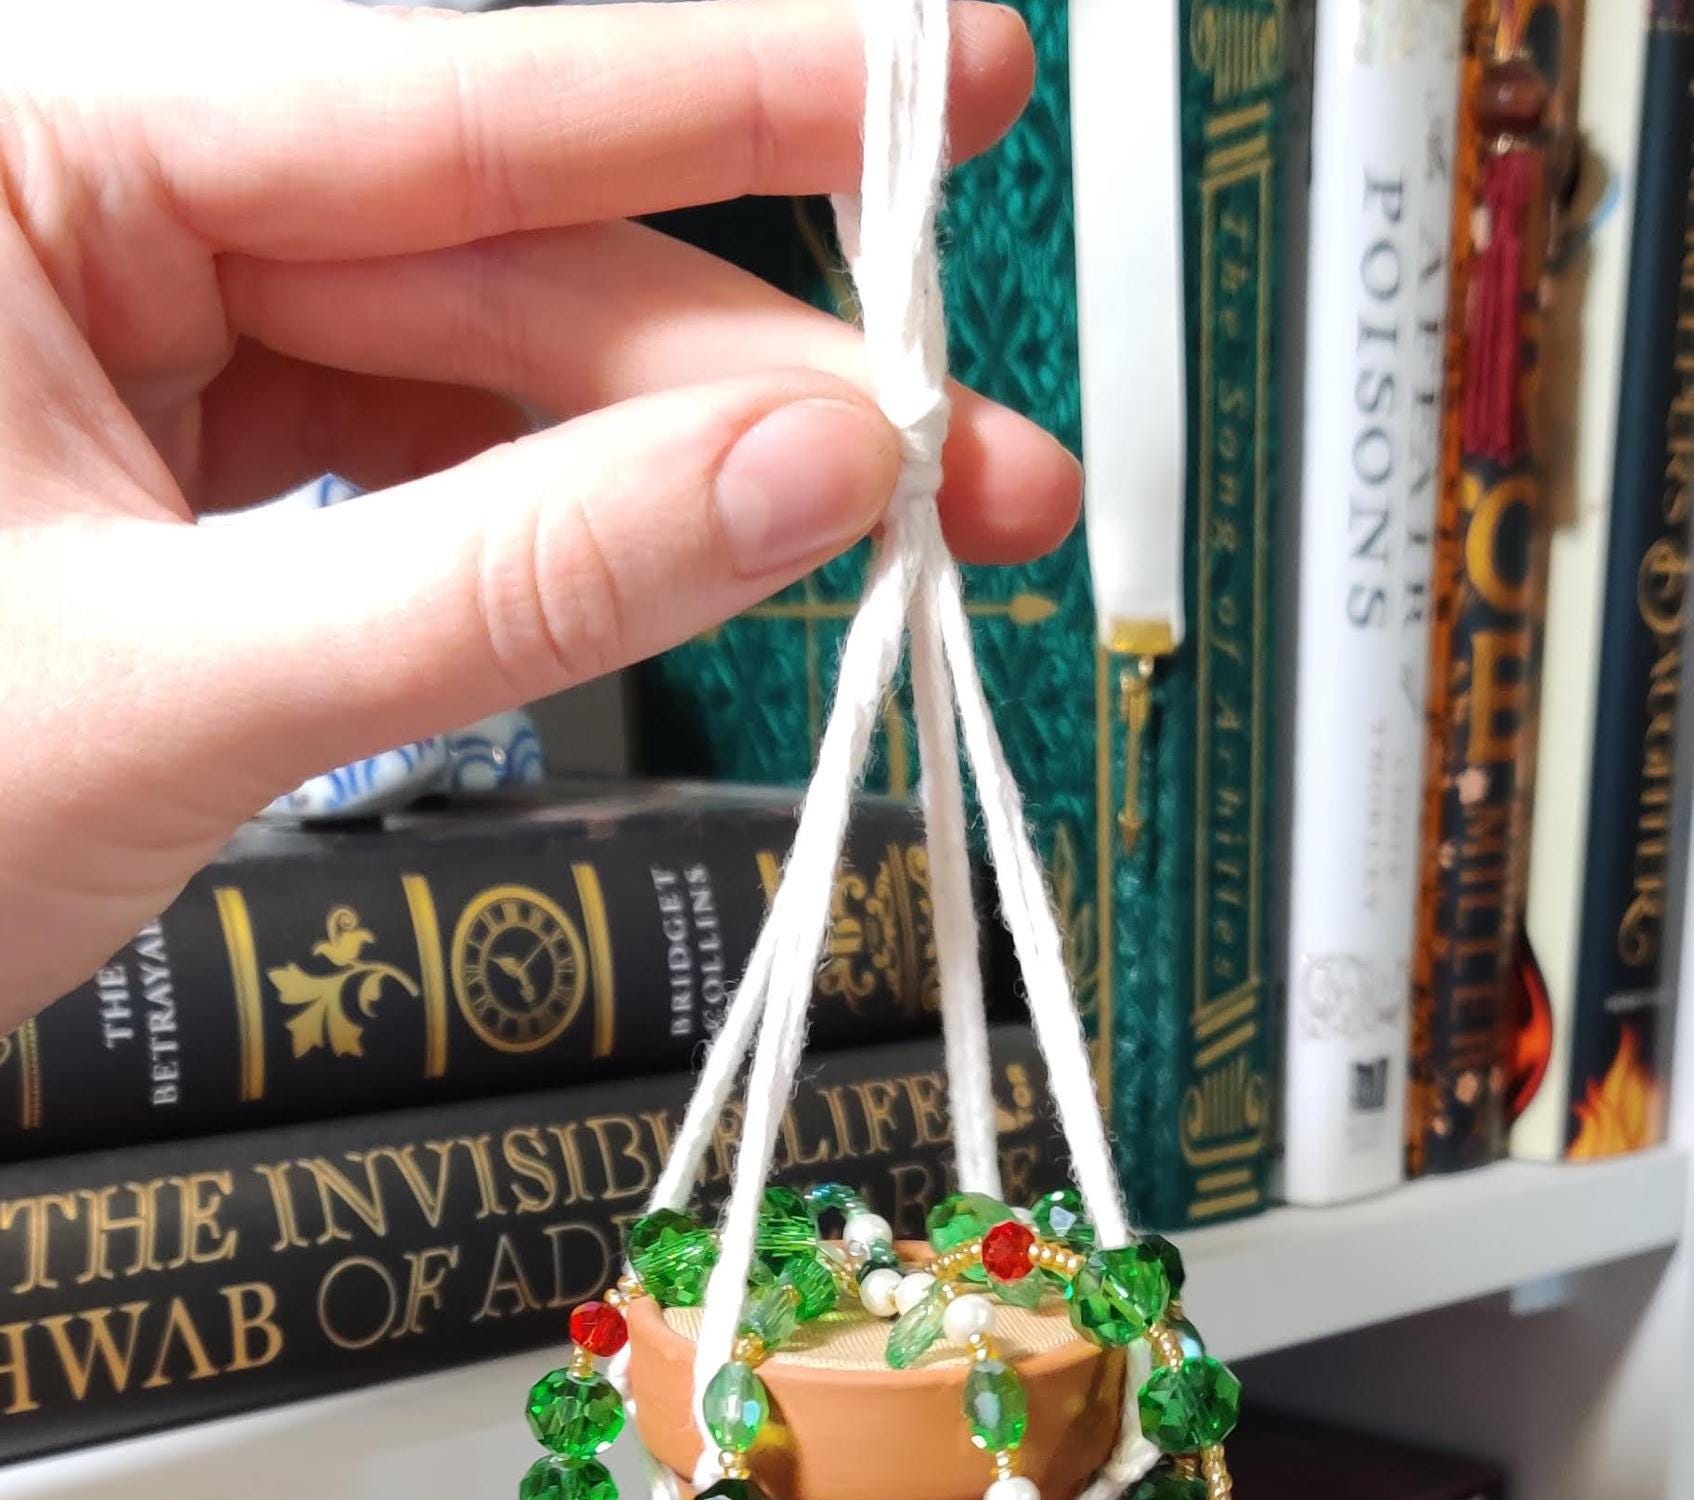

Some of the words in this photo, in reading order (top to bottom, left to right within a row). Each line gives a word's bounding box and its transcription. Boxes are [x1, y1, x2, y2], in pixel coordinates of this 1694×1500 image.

[1211, 380, 1247, 554] Song
[1347, 164, 1407, 631] POISONS
[1211, 693, 1245, 979] Achilles
[96, 963, 135, 1049] THE
[136, 916, 181, 1106] BETRAYAL
[649, 864, 694, 1037] BRIDGET
[0, 1169, 238, 1295] THE
[779, 1073, 954, 1170] LIFE
[317, 1246, 460, 1350] OF
